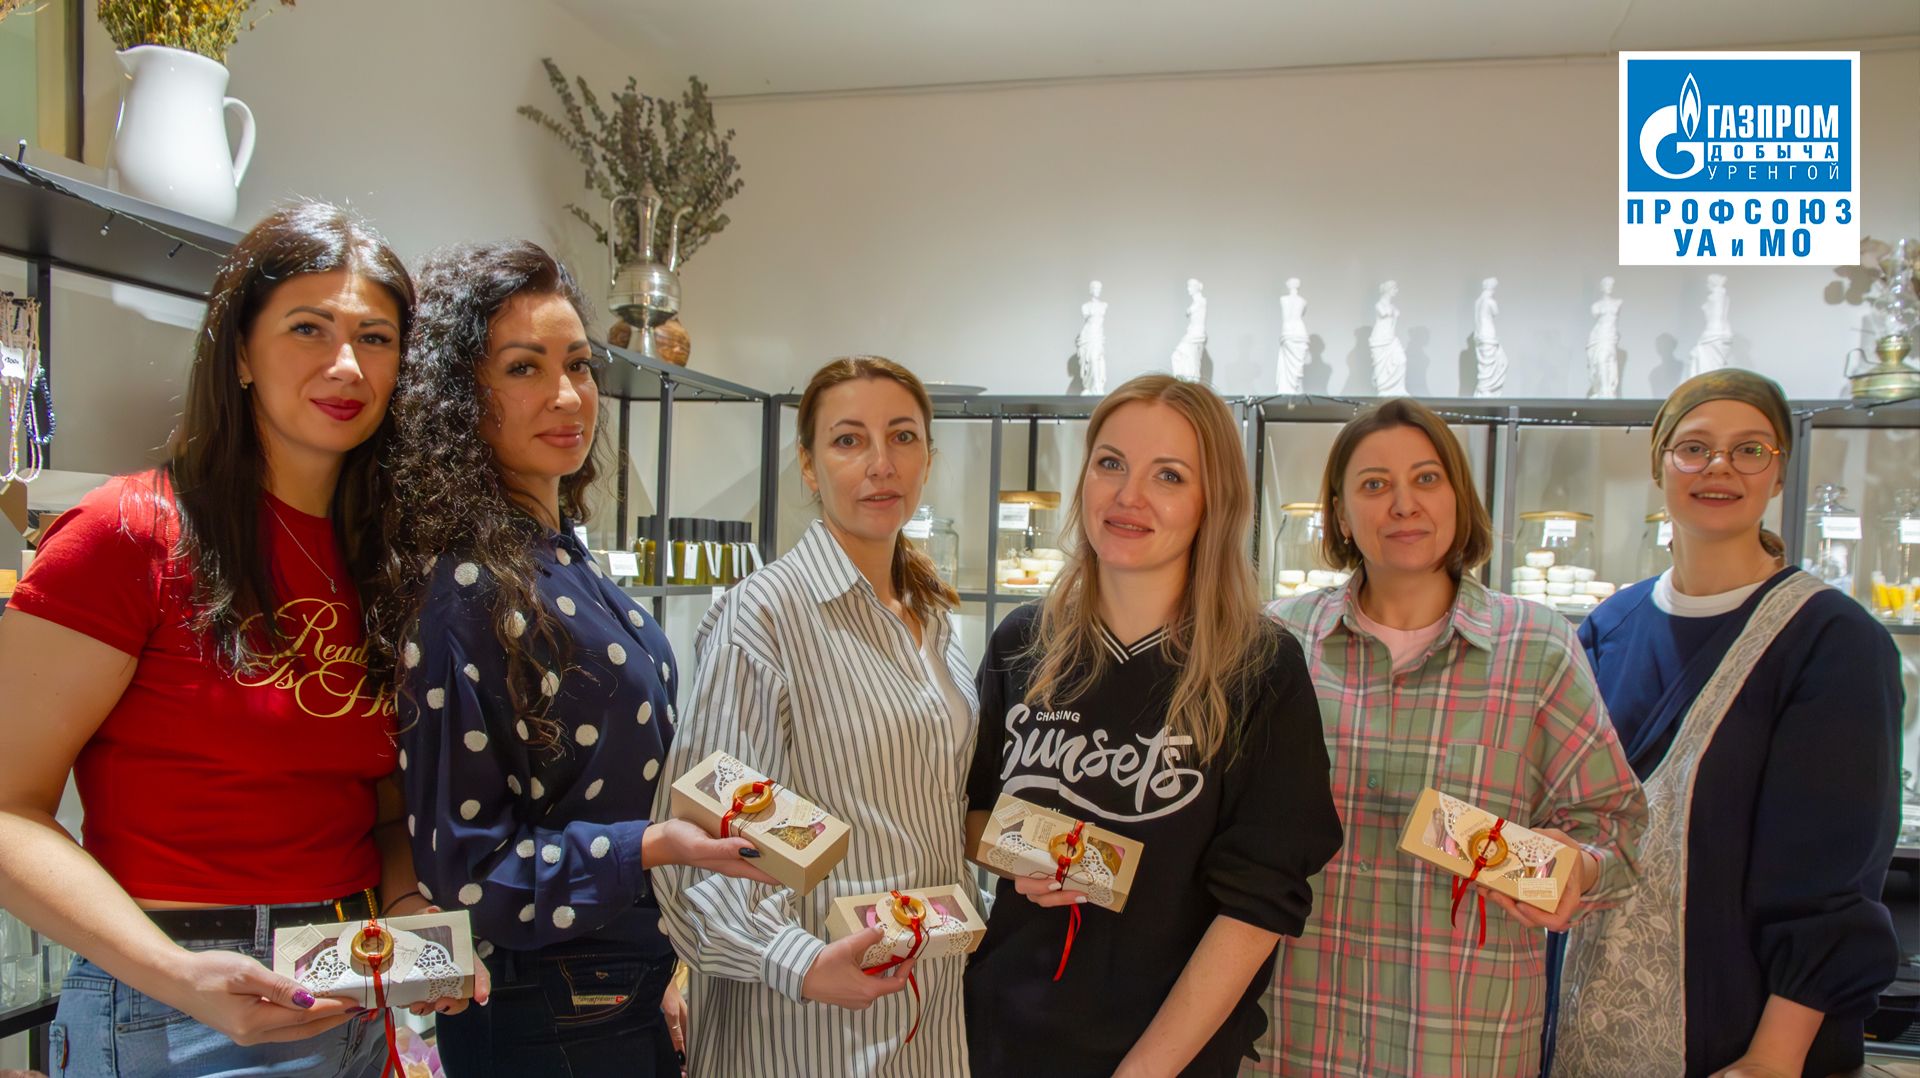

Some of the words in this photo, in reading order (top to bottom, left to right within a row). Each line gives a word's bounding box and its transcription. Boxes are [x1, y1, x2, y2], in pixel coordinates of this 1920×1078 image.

[240, 597, 370, 665] Read
[1035, 710, 1081, 723] CHASING
[1000, 703, 1200, 815] Sunsets
